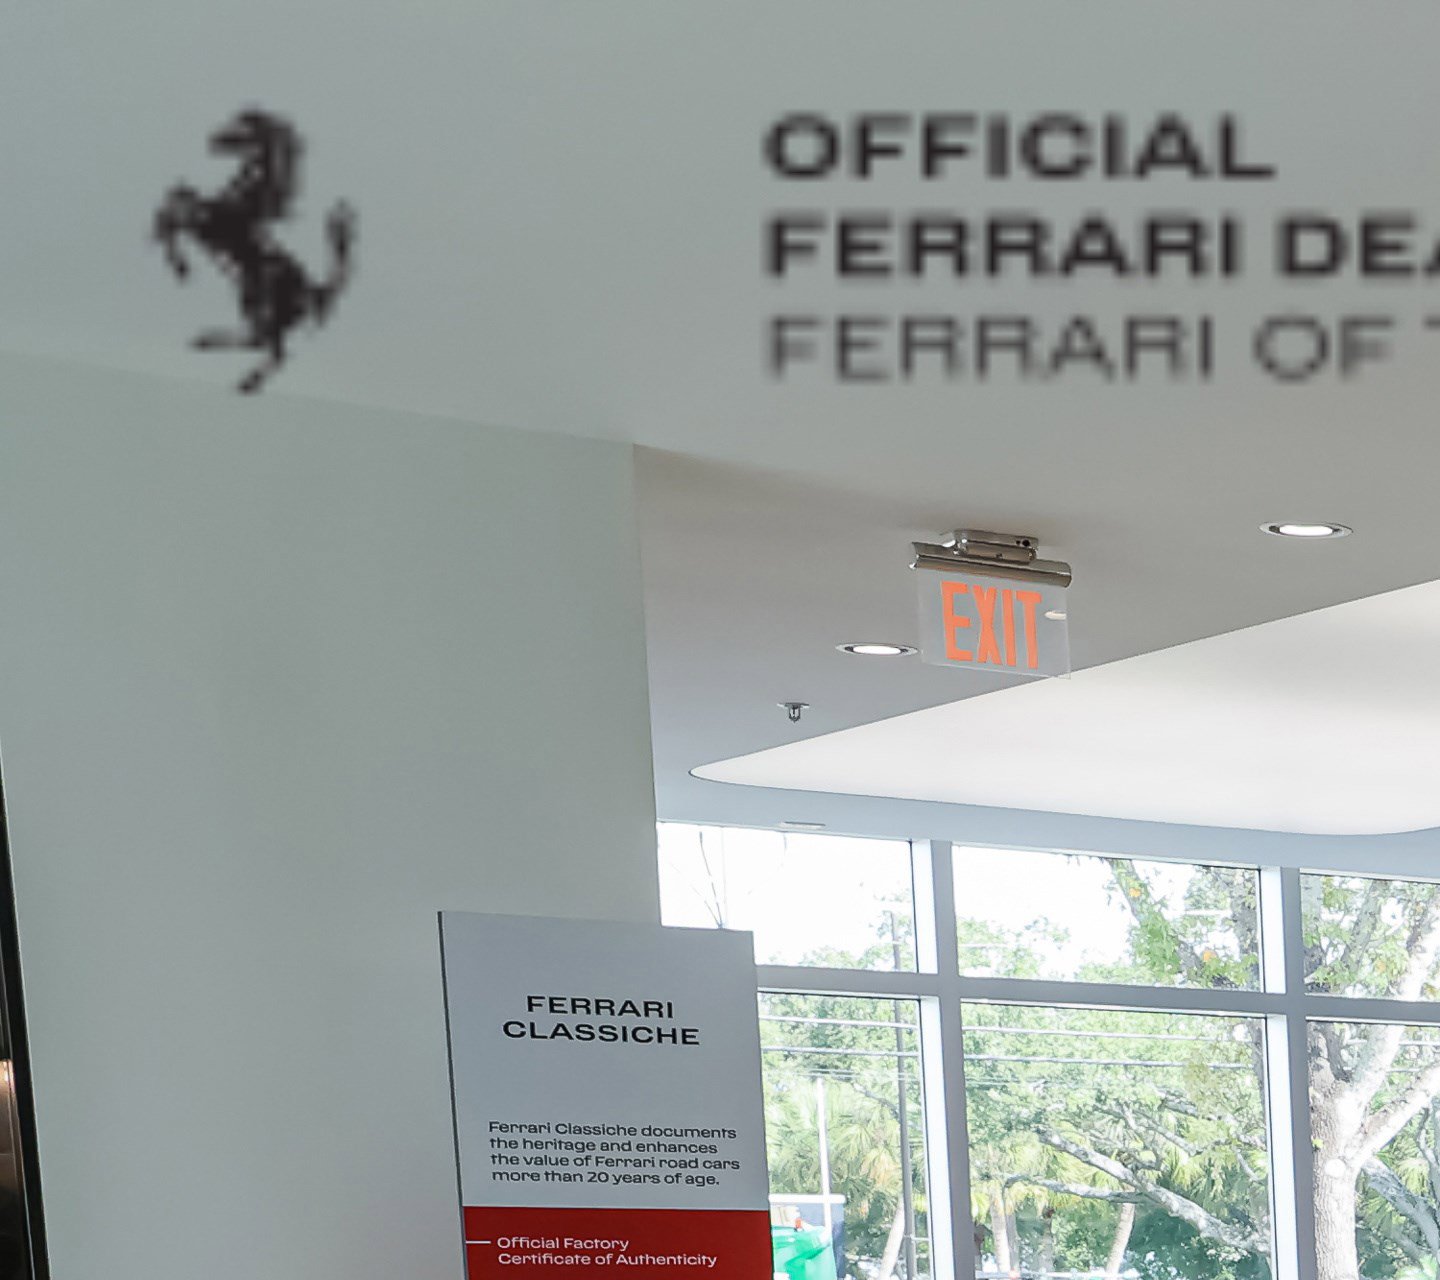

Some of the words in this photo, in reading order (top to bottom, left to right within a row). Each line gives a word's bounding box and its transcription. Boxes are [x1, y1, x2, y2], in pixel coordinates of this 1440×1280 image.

[941, 580, 1042, 670] EXIT
[526, 995, 673, 1019] FERRARI
[502, 1020, 700, 1045] CLASSICHE
[488, 1121, 551, 1134] Ferrari
[554, 1122, 638, 1137] Classiche
[640, 1124, 737, 1139] documents
[489, 1137, 519, 1150] the
[522, 1137, 596, 1154] heritage
[600, 1140, 633, 1152] and
[635, 1140, 718, 1154] enhances
[490, 1153, 520, 1166] the
[522, 1154, 570, 1167] value
[572, 1154, 592, 1167] of
[595, 1155, 656, 1168] Ferrari
[659, 1157, 699, 1169] road
[702, 1160, 741, 1170] cars
[492, 1171, 541, 1182] more
[543, 1170, 584, 1183] than
[587, 1171, 610, 1183] 20
[611, 1173, 661, 1186] years
[663, 1172, 683, 1185] of
[684, 1174, 720, 1187] age.
[497, 1236, 560, 1249] Official
[563, 1237, 629, 1252] Factory
[498, 1252, 591, 1265] Certificate
[595, 1253, 614, 1265] of
[615, 1253, 717, 1268] Authenticity
